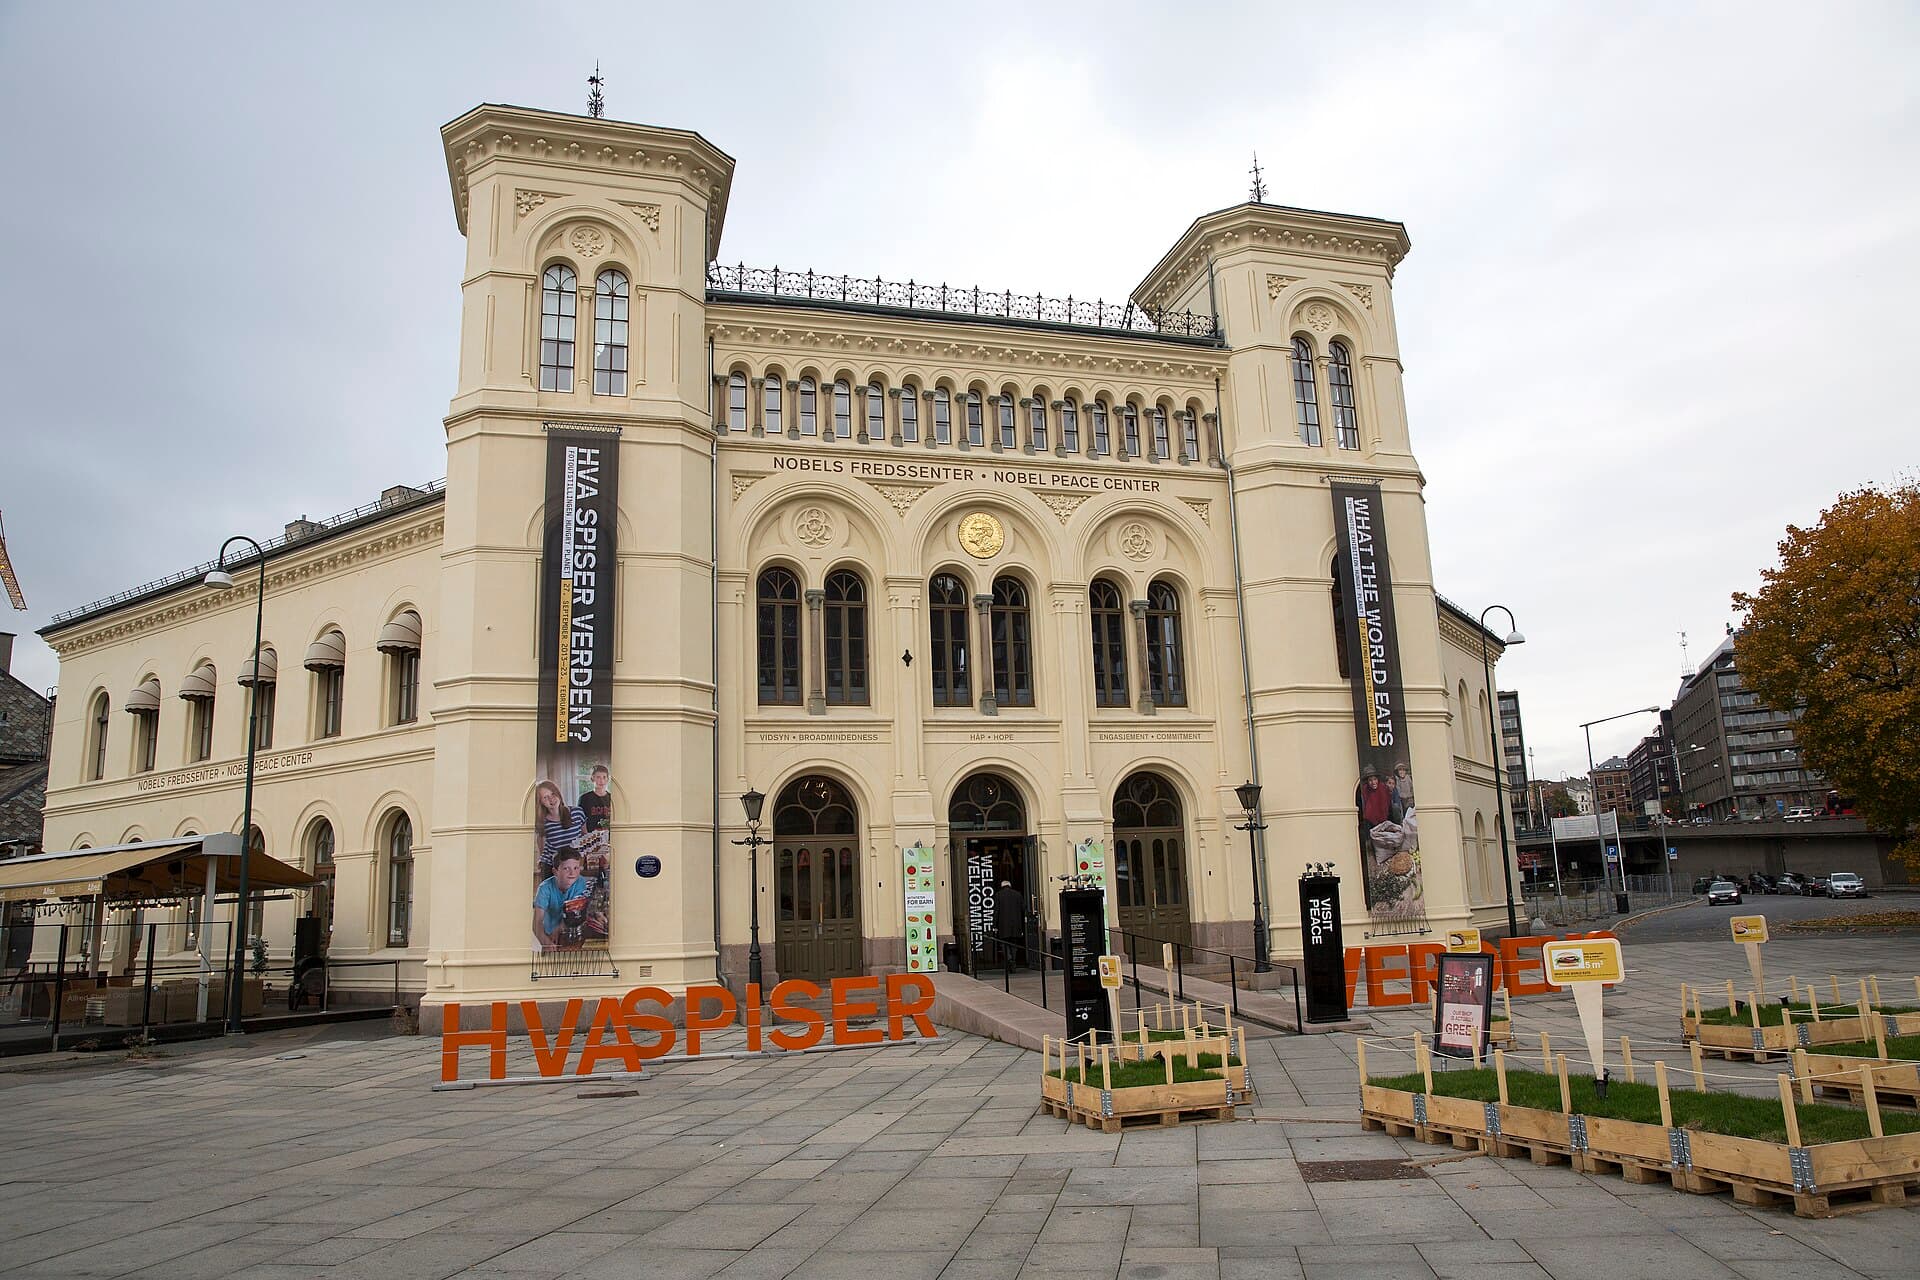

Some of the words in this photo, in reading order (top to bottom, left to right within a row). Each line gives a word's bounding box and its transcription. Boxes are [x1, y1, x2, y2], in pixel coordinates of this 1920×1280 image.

[566, 450, 575, 517] FOTOUTSTILLINGEN
[577, 448, 600, 499] HVA
[773, 456, 844, 473] NOBELS
[851, 461, 974, 481] FREDSSENTER
[994, 471, 1047, 485] NOBEL
[1051, 474, 1099, 489] PEACE
[1103, 477, 1160, 492] CENTER
[564, 520, 572, 545] HUNGRY
[1354, 498, 1374, 556] WHAT
[563, 549, 571, 575] PLANET
[573, 507, 598, 605] SPISER
[1361, 562, 1379, 602] THE
[561, 601, 569, 639] SEPTEMBER
[1366, 609, 1387, 685] WORLD
[559, 685, 567, 716] FEBRUAR
[568, 614, 595, 743] VERDEN?
[1374, 692, 1394, 747] EATS
[137, 777, 165, 791] NOBELS
[167, 769, 219, 788] FREDSSENTER
[227, 764, 248, 777] NOBE
[254, 758, 278, 773] PEACE
[280, 752, 313, 767] CENTER
[968, 855, 984, 952] VELKOMMEN
[980, 854, 994, 932] WELCOME
[1321, 897, 1333, 932] VISIT
[1309, 899, 1322, 945] PEACE
[442, 997, 642, 1082] HVA
[624, 973, 939, 1060] SPISER
[1446, 1023, 1478, 1036] GREE
